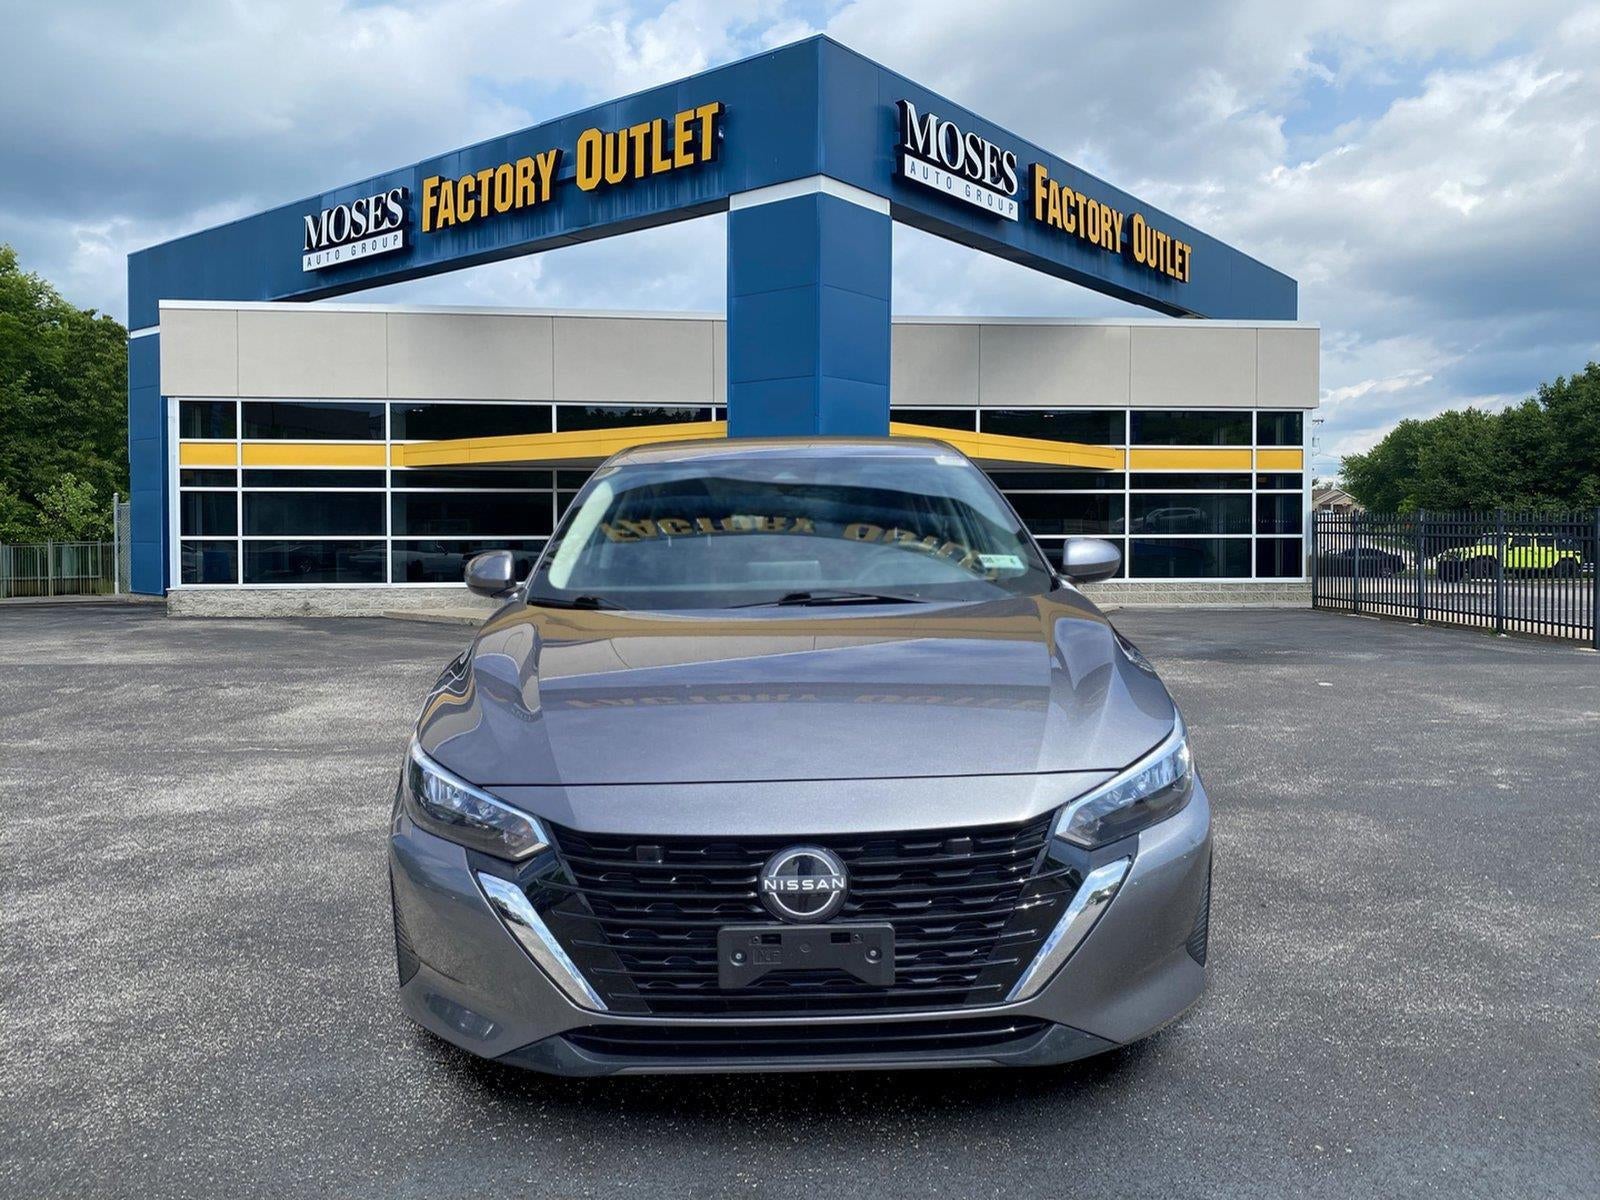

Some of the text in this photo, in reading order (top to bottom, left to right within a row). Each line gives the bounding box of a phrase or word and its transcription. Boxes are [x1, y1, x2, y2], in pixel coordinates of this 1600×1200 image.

[422, 102, 720, 233] FACTORY OUTLET
[904, 100, 1018, 196] MOSES
[303, 187, 405, 252] MOSES
[909, 161, 1014, 214] AUTO GROUP
[306, 235, 399, 267] AUTO GROUP
[1034, 162, 1191, 282] FACTORY OUTLET
[764, 877, 844, 891] NISSAN
